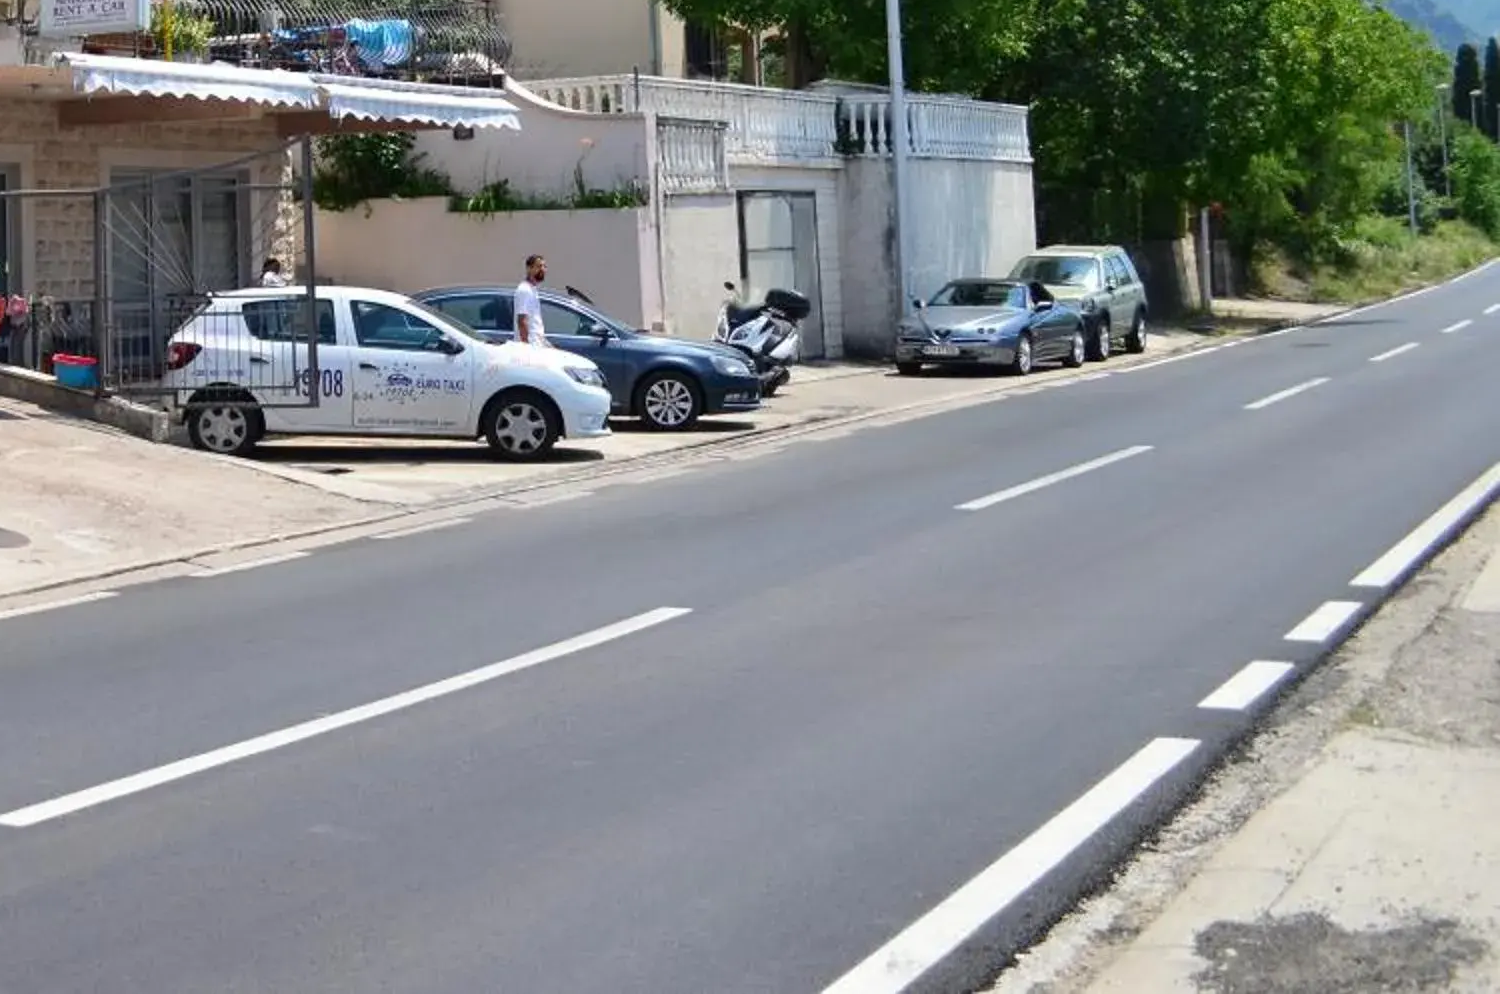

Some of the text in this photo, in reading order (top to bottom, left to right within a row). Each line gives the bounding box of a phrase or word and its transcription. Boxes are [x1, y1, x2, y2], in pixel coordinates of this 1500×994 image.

[53, 5, 82, 17] RENT
[101, 1, 125, 14] CAR
[415, 378, 440, 389] EURO
